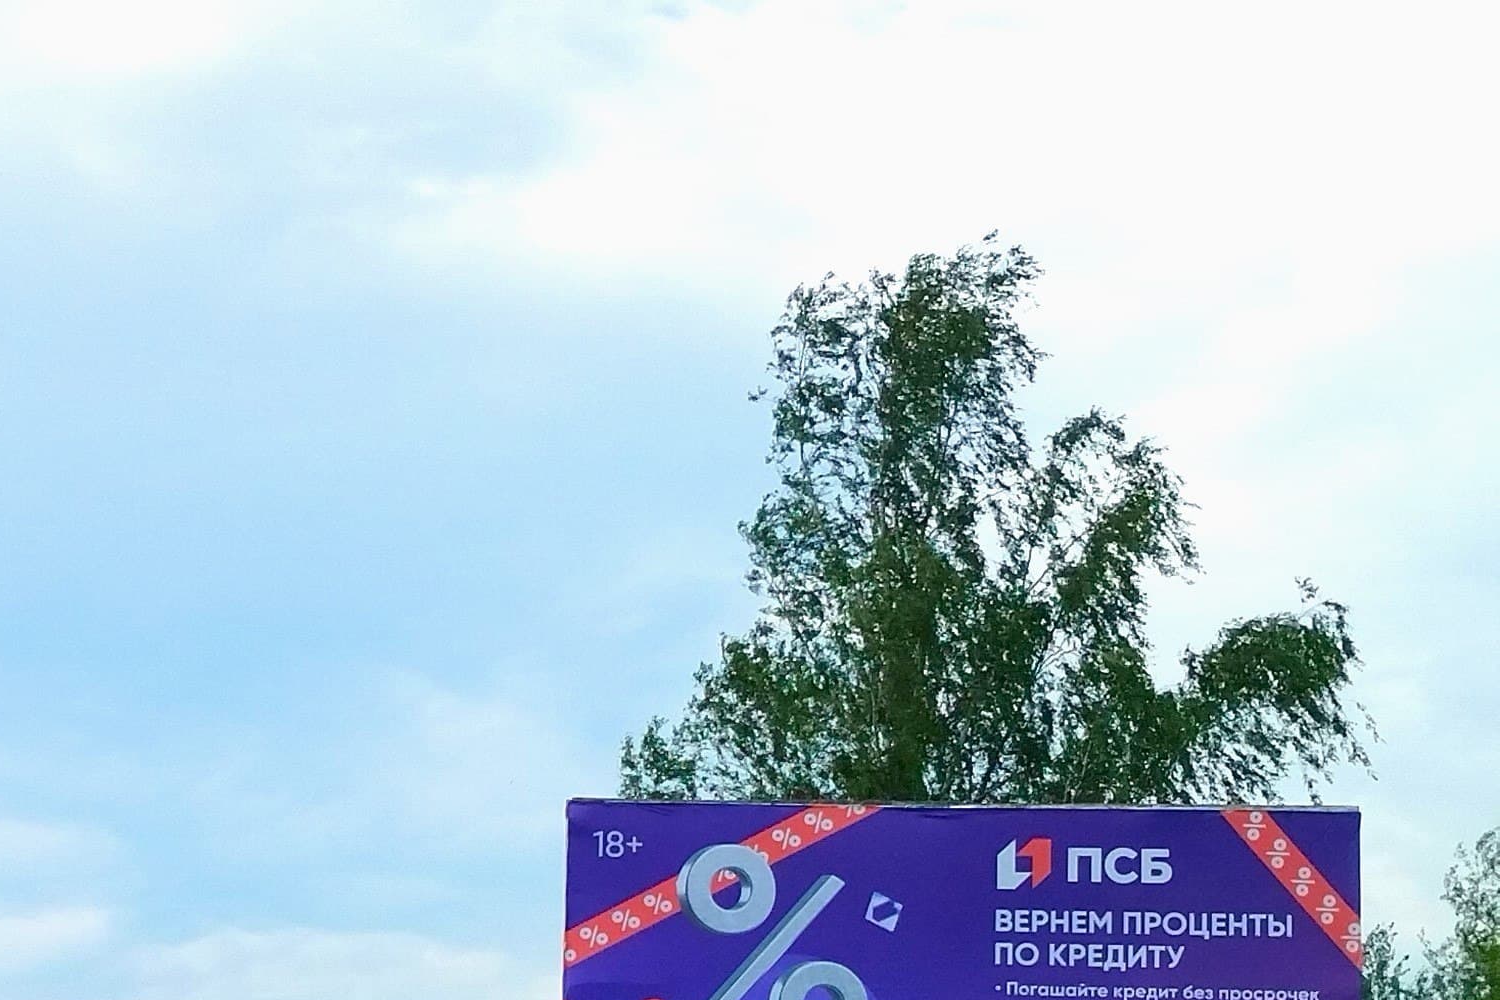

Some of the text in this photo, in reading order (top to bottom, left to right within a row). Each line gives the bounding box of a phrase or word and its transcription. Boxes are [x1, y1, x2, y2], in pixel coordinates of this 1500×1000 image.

[592, 830, 643, 858] 18+
[1067, 847, 1173, 884] ПСБ
[995, 909, 1293, 940] ВЕРНЕМ ПРОЦЕНТЫ
[994, 942, 1185, 972] ПО КРЕДИТУ
[1006, 981, 1109, 998] Погашайте
[1182, 984, 1214, 1000] без
